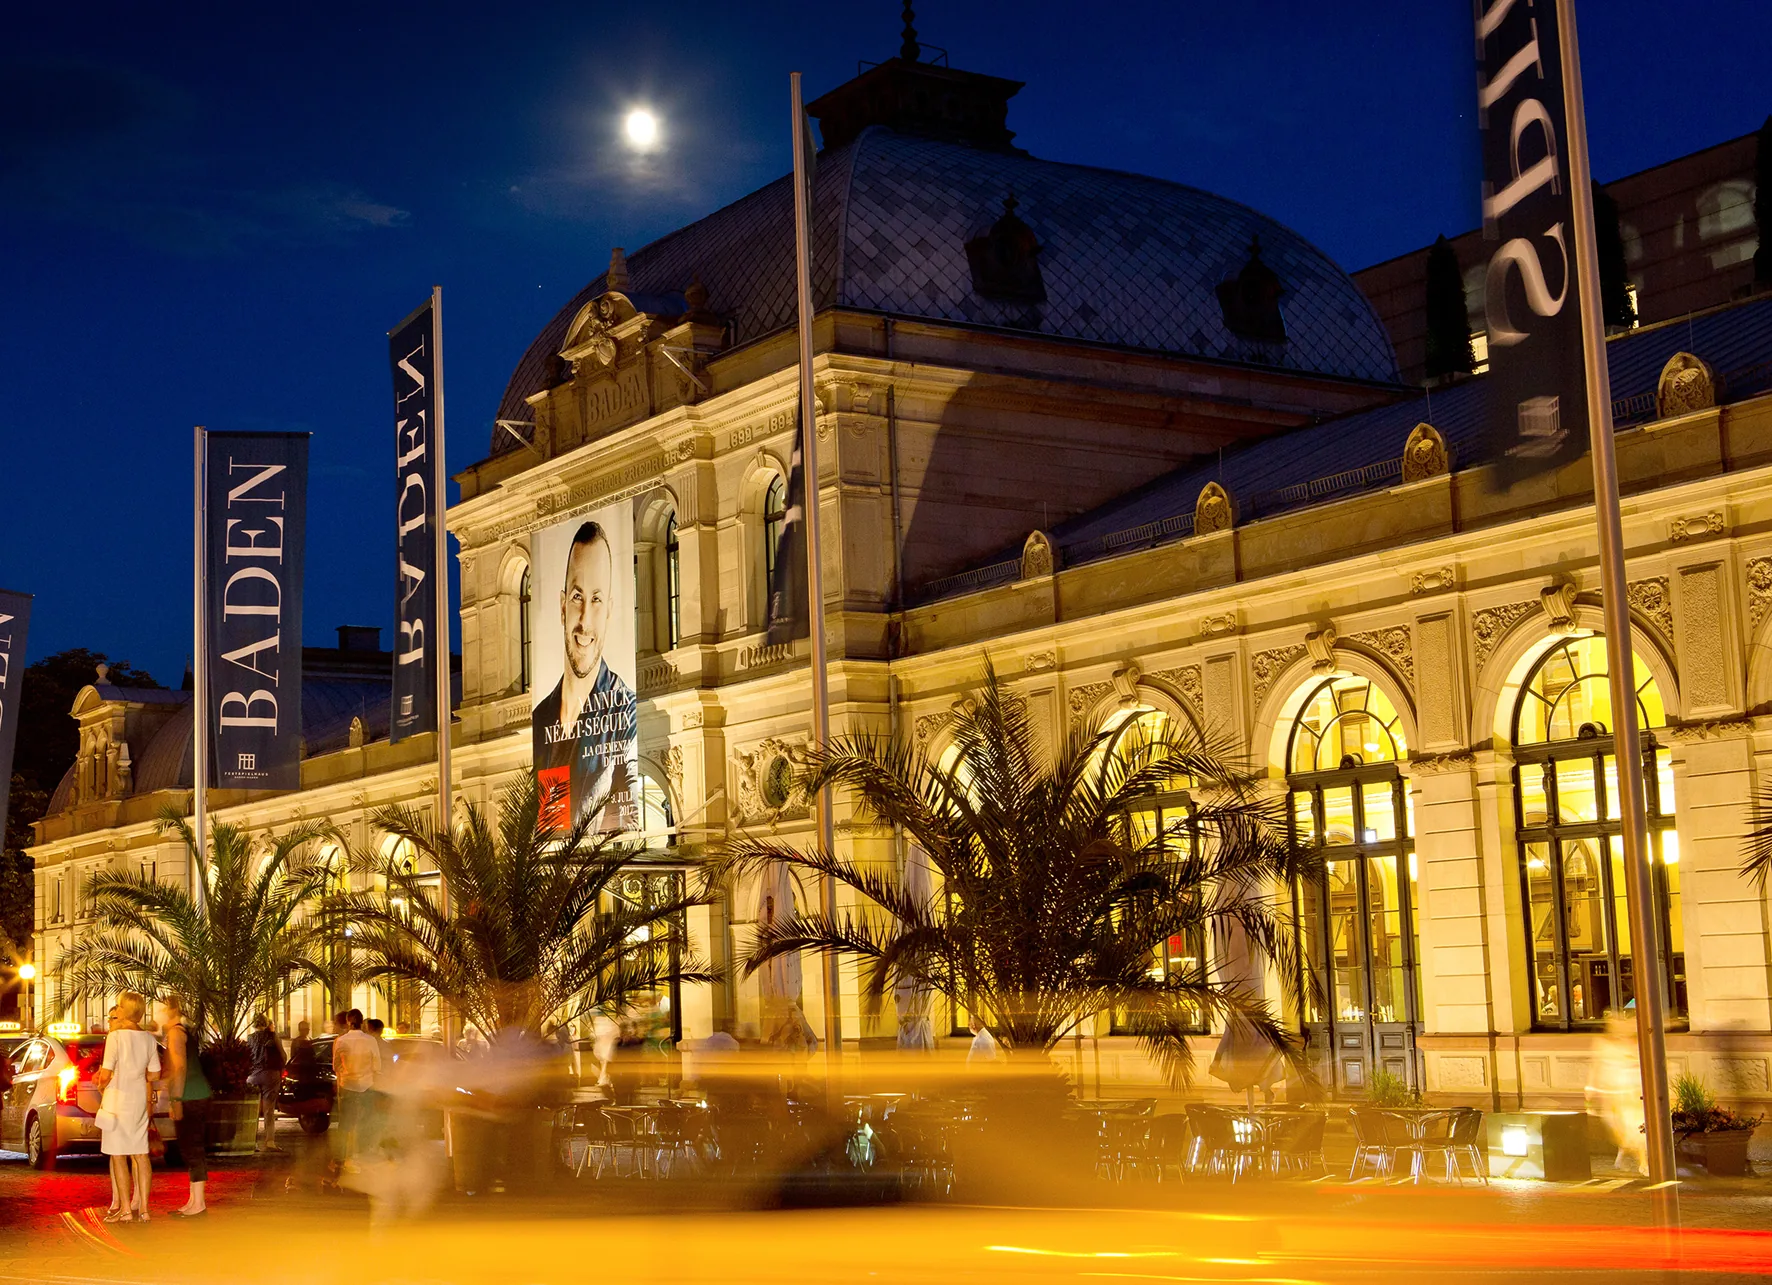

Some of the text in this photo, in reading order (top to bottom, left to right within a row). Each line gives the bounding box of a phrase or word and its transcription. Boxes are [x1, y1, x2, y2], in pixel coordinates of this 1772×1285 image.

[588, 374, 645, 425] BADEN
[766, 407, 796, 435] 1894
[219, 455, 287, 736] BADEN
[578, 686, 632, 714] YANNICK
[544, 710, 632, 745] NÉZET-SÉGUIN
